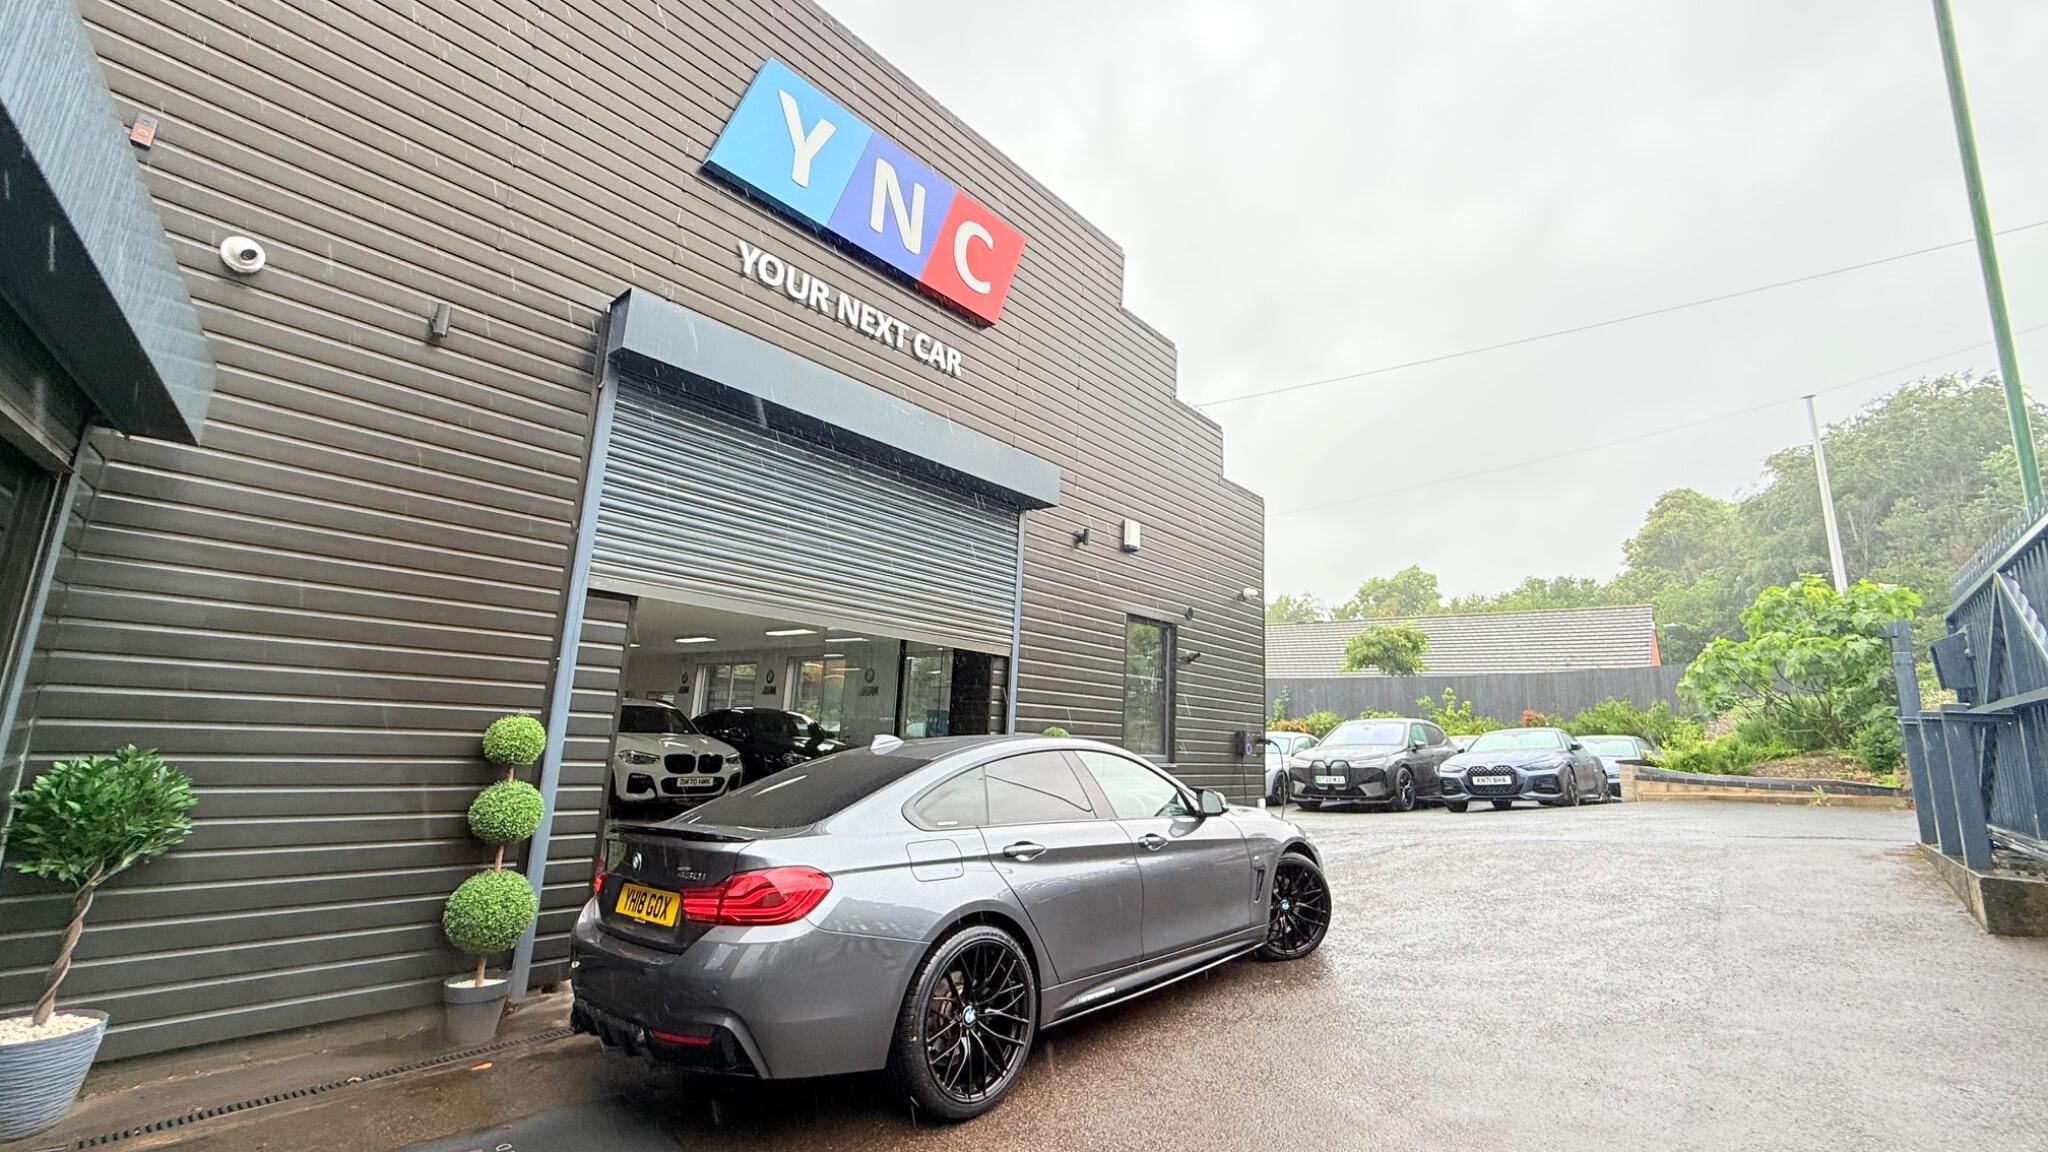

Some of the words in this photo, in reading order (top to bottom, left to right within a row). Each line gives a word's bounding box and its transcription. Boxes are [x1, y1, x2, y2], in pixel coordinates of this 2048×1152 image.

[778, 88, 994, 296] YNC
[738, 240, 829, 314] YOUR
[838, 292, 911, 350] NEXT
[914, 332, 963, 377] CAR
[623, 888, 648, 914] YH18
[646, 893, 673, 921] GOX
